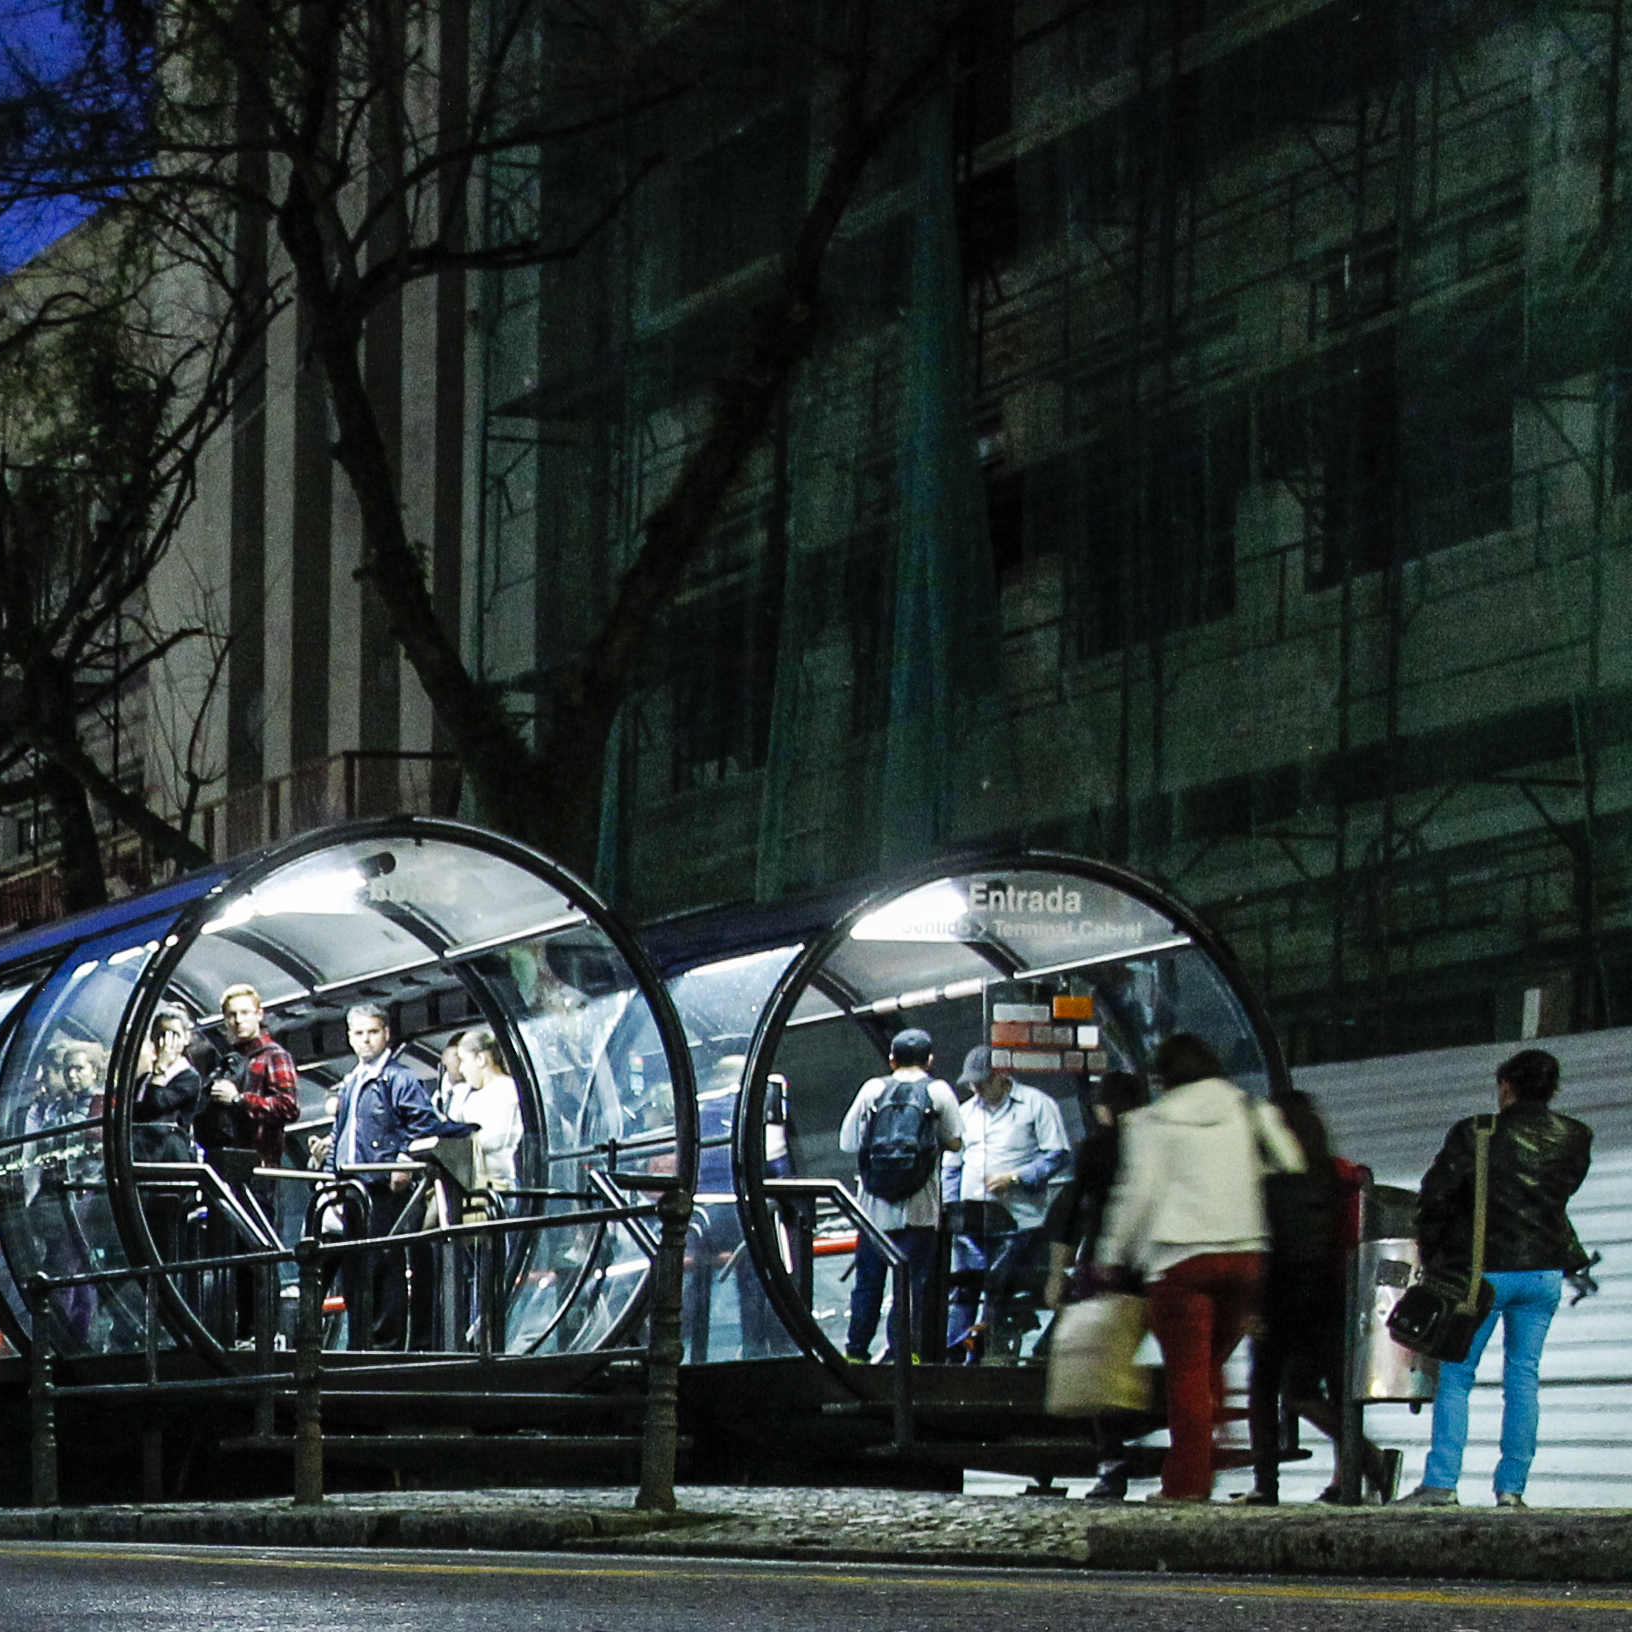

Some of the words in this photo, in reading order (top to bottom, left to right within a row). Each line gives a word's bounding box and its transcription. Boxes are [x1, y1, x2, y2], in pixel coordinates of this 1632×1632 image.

[968, 882, 1083, 914] Entrada
[993, 919, 1074, 938] Terminal
[1079, 920, 1143, 940] Cabral
